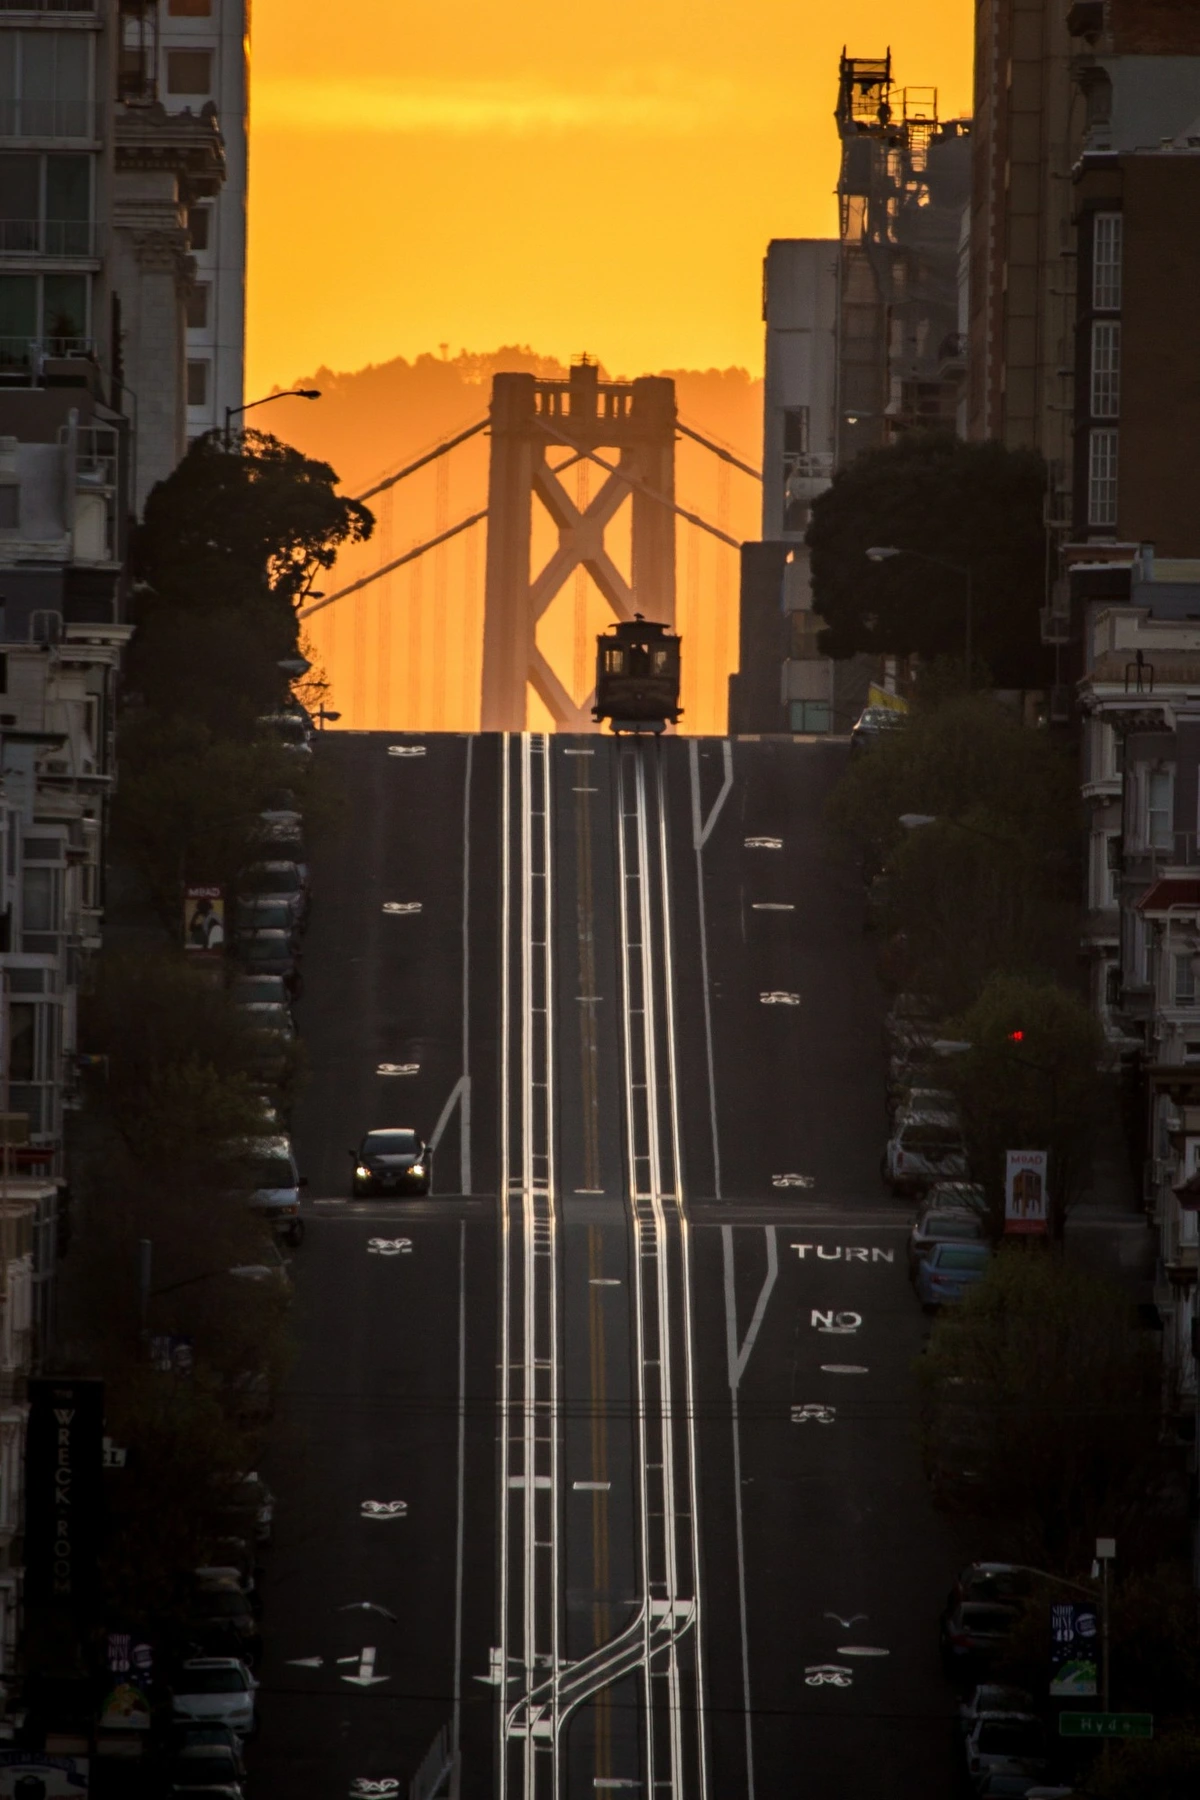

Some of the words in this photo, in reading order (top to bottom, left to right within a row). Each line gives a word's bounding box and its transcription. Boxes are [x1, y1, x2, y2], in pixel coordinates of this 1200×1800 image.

[790, 1244, 894, 1263] TURN
[811, 1309, 862, 1329] NO
[53, 1519, 73, 1595] ROOM
